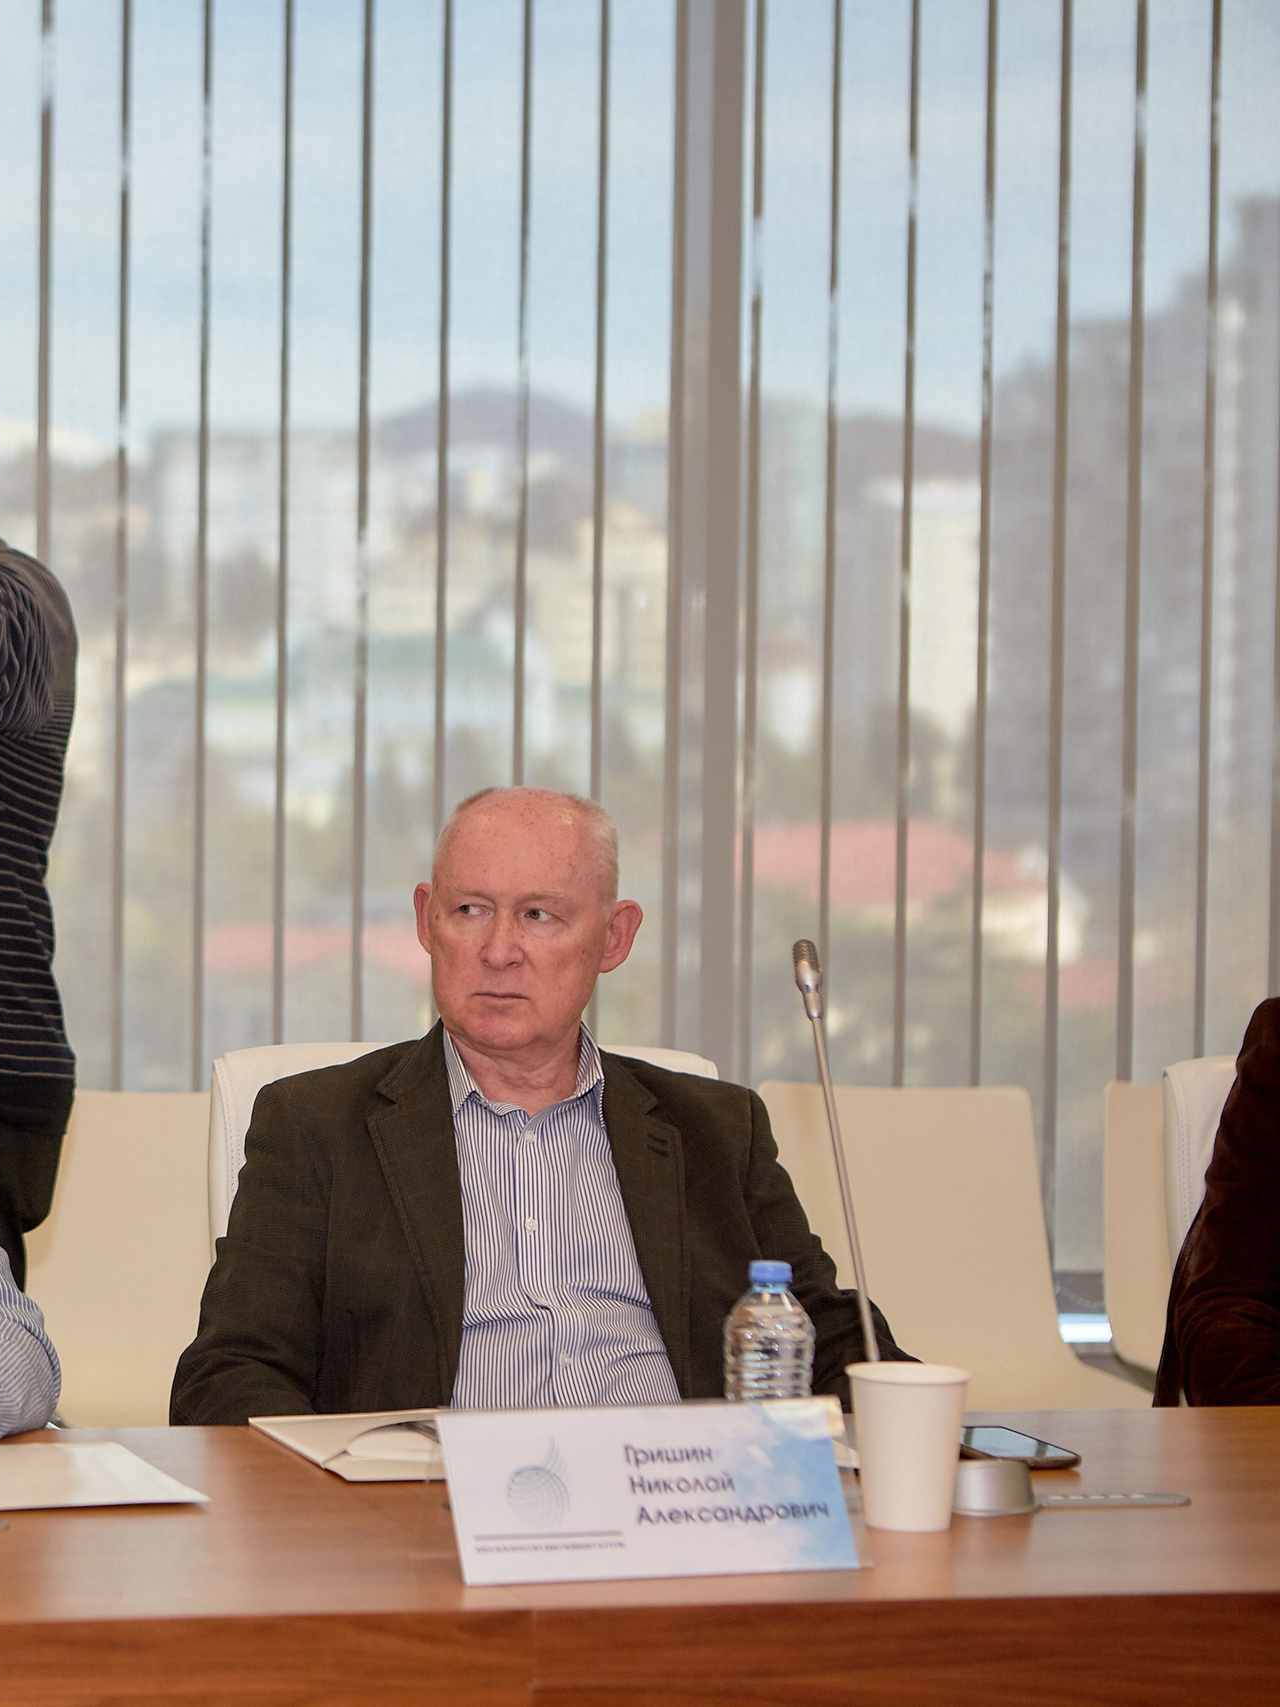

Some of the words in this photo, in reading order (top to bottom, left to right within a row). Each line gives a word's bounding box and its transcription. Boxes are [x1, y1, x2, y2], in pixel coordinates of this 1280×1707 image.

[624, 1444, 714, 1468] Гришин
[630, 1471, 736, 1495] Николай
[637, 1502, 831, 1525] Александрович
